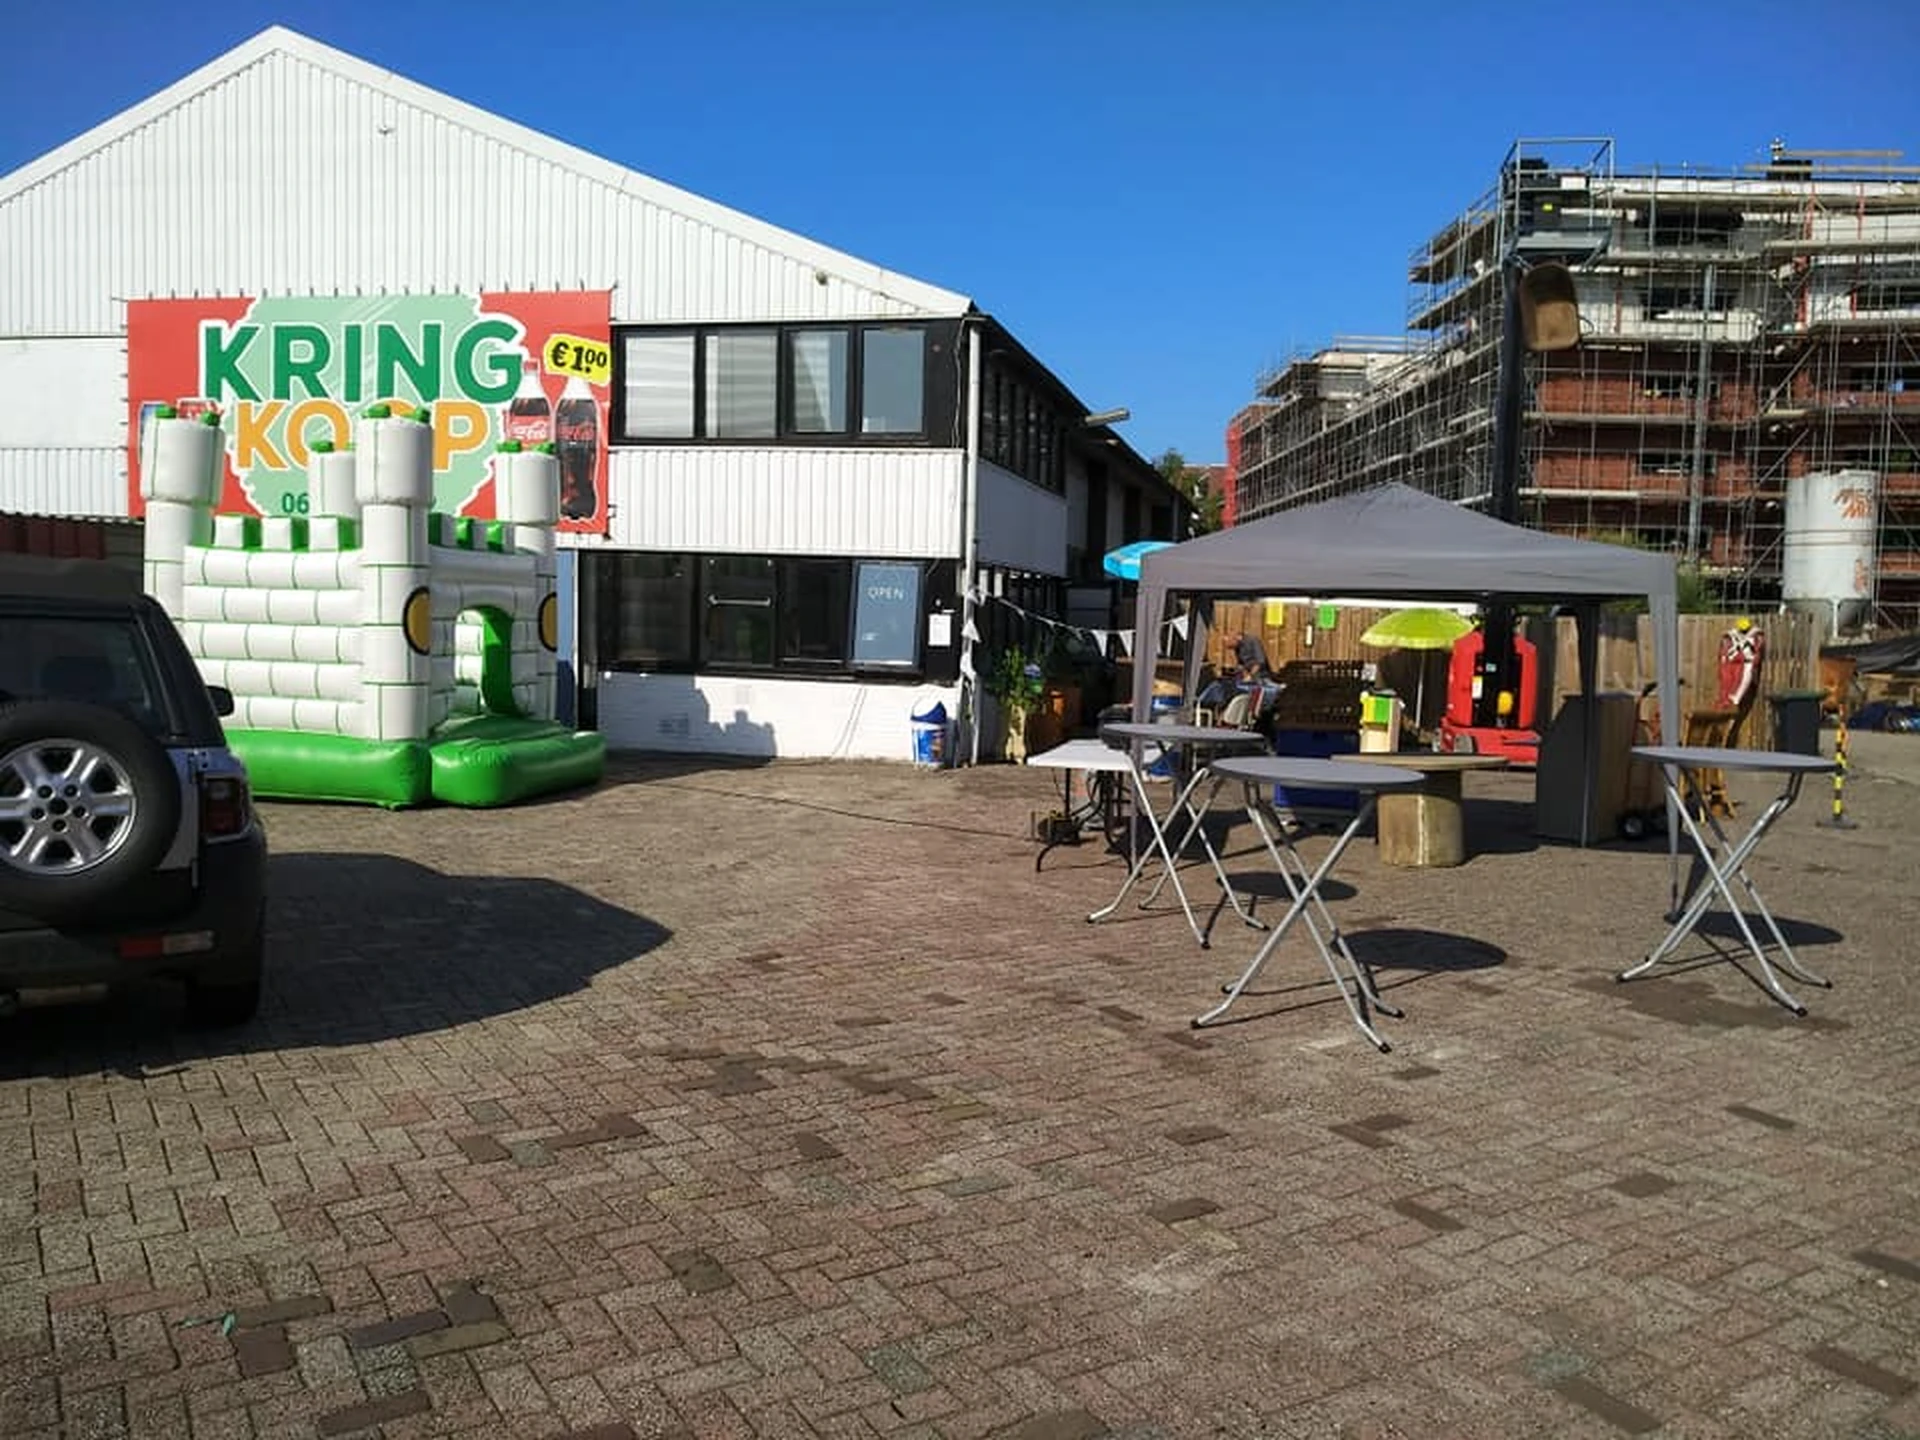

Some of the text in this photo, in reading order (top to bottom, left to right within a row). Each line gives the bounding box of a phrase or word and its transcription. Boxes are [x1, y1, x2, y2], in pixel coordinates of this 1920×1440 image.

[204, 319, 524, 404] KRING
[236, 399, 489, 470] KOP
[867, 586, 905, 600] OPEN
